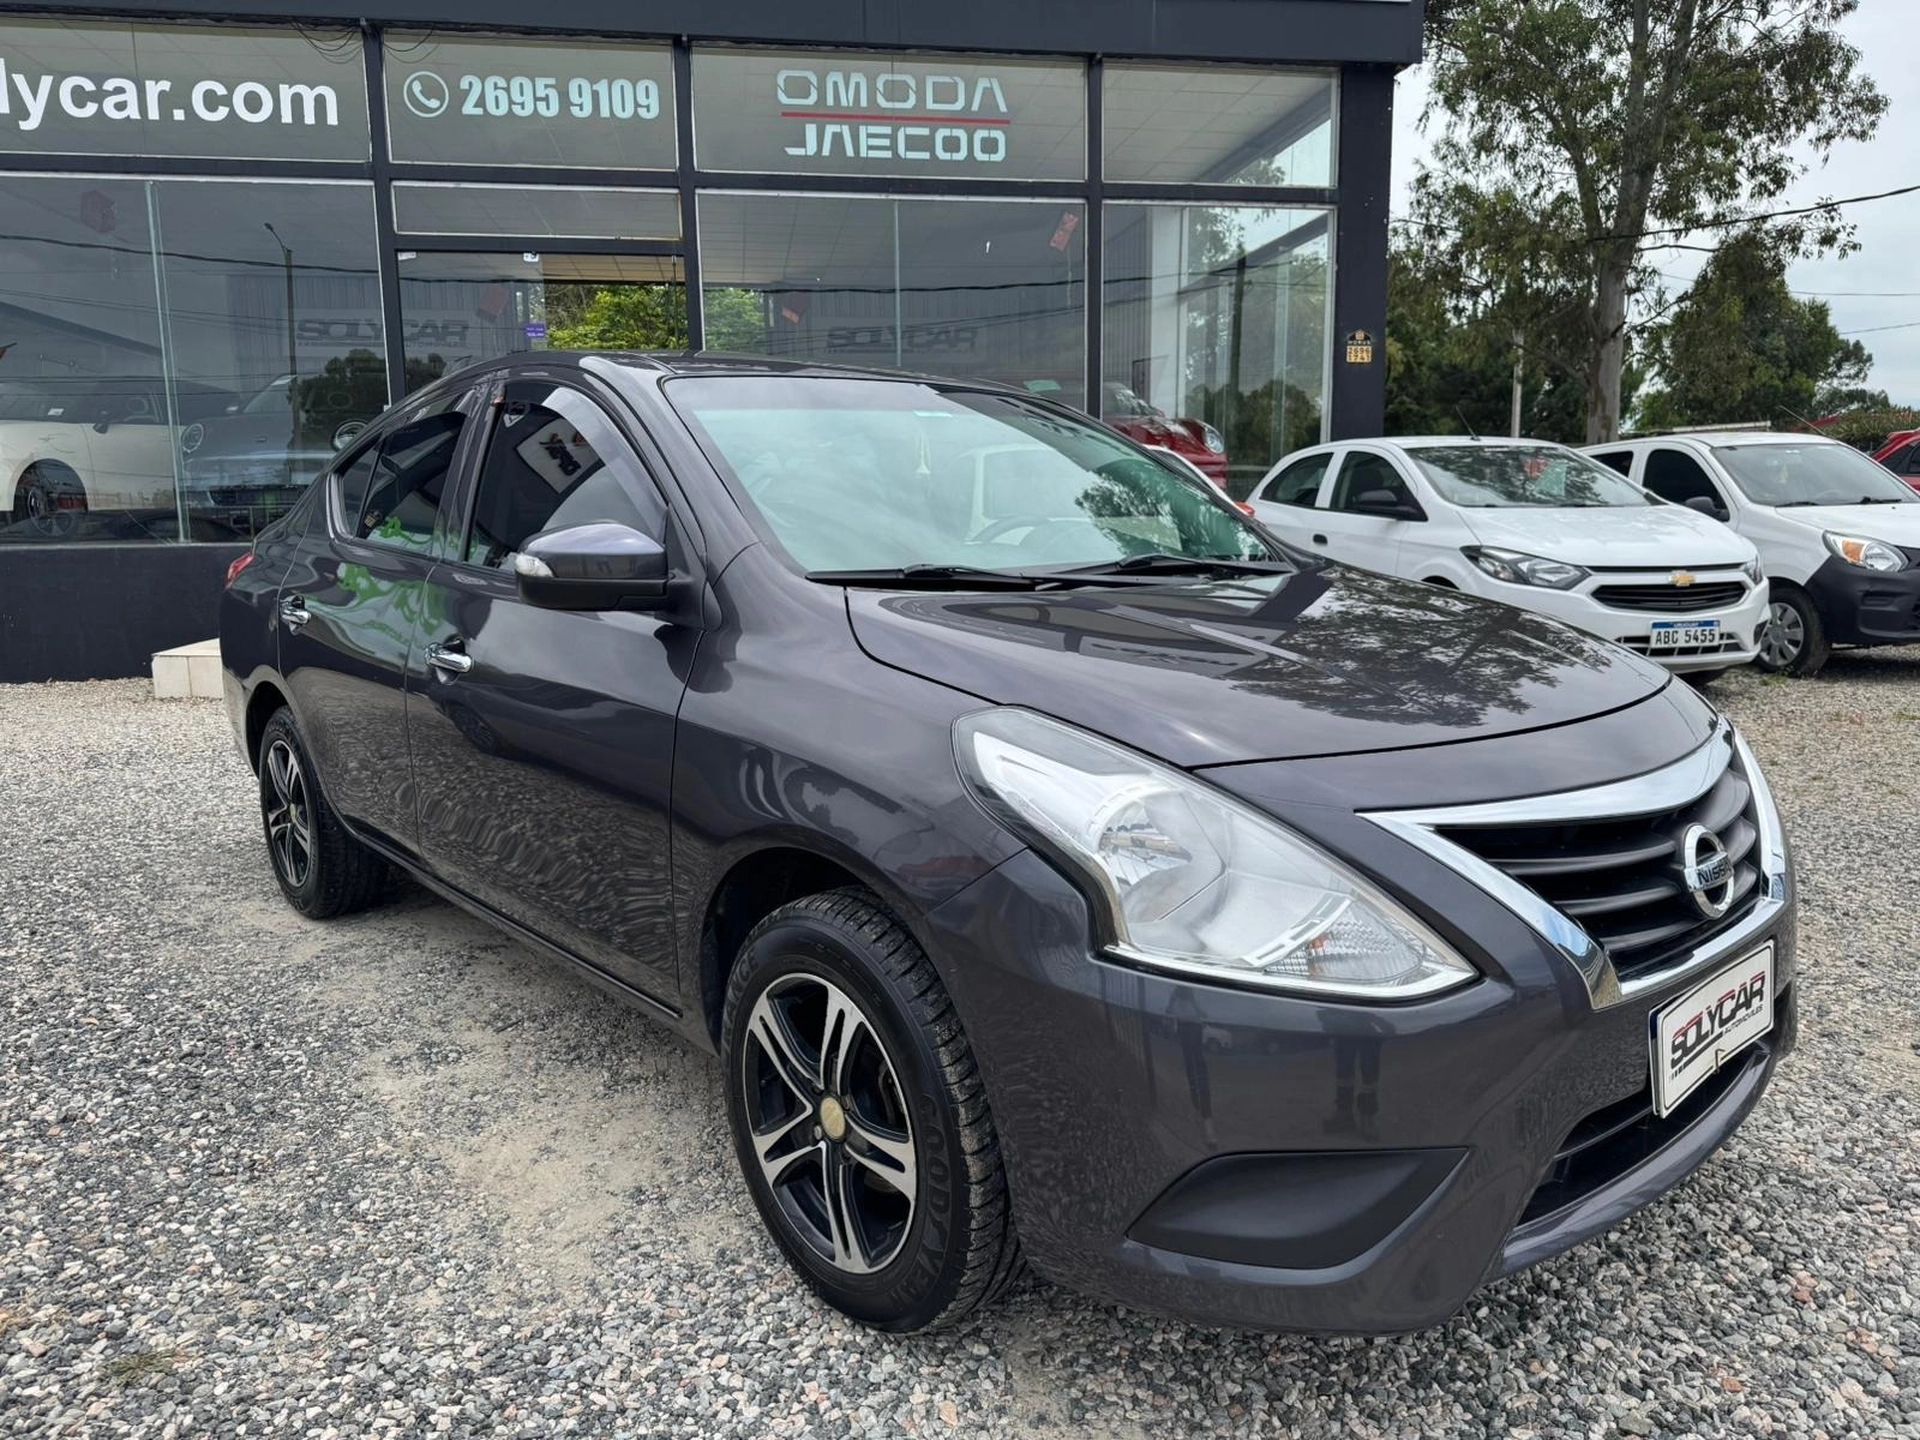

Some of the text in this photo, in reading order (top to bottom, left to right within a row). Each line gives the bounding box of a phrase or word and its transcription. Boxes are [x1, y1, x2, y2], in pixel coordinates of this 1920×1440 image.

[0, 57, 339, 131] lycar.com
[461, 75, 661, 120] 2695 9109
[777, 69, 1008, 113] OMODA
[785, 123, 1007, 163] JAECOO
[1655, 628, 1715, 645] ABC 5455
[1697, 862, 1732, 885] NISSA
[1670, 970, 1766, 1070] SOLYCAR
